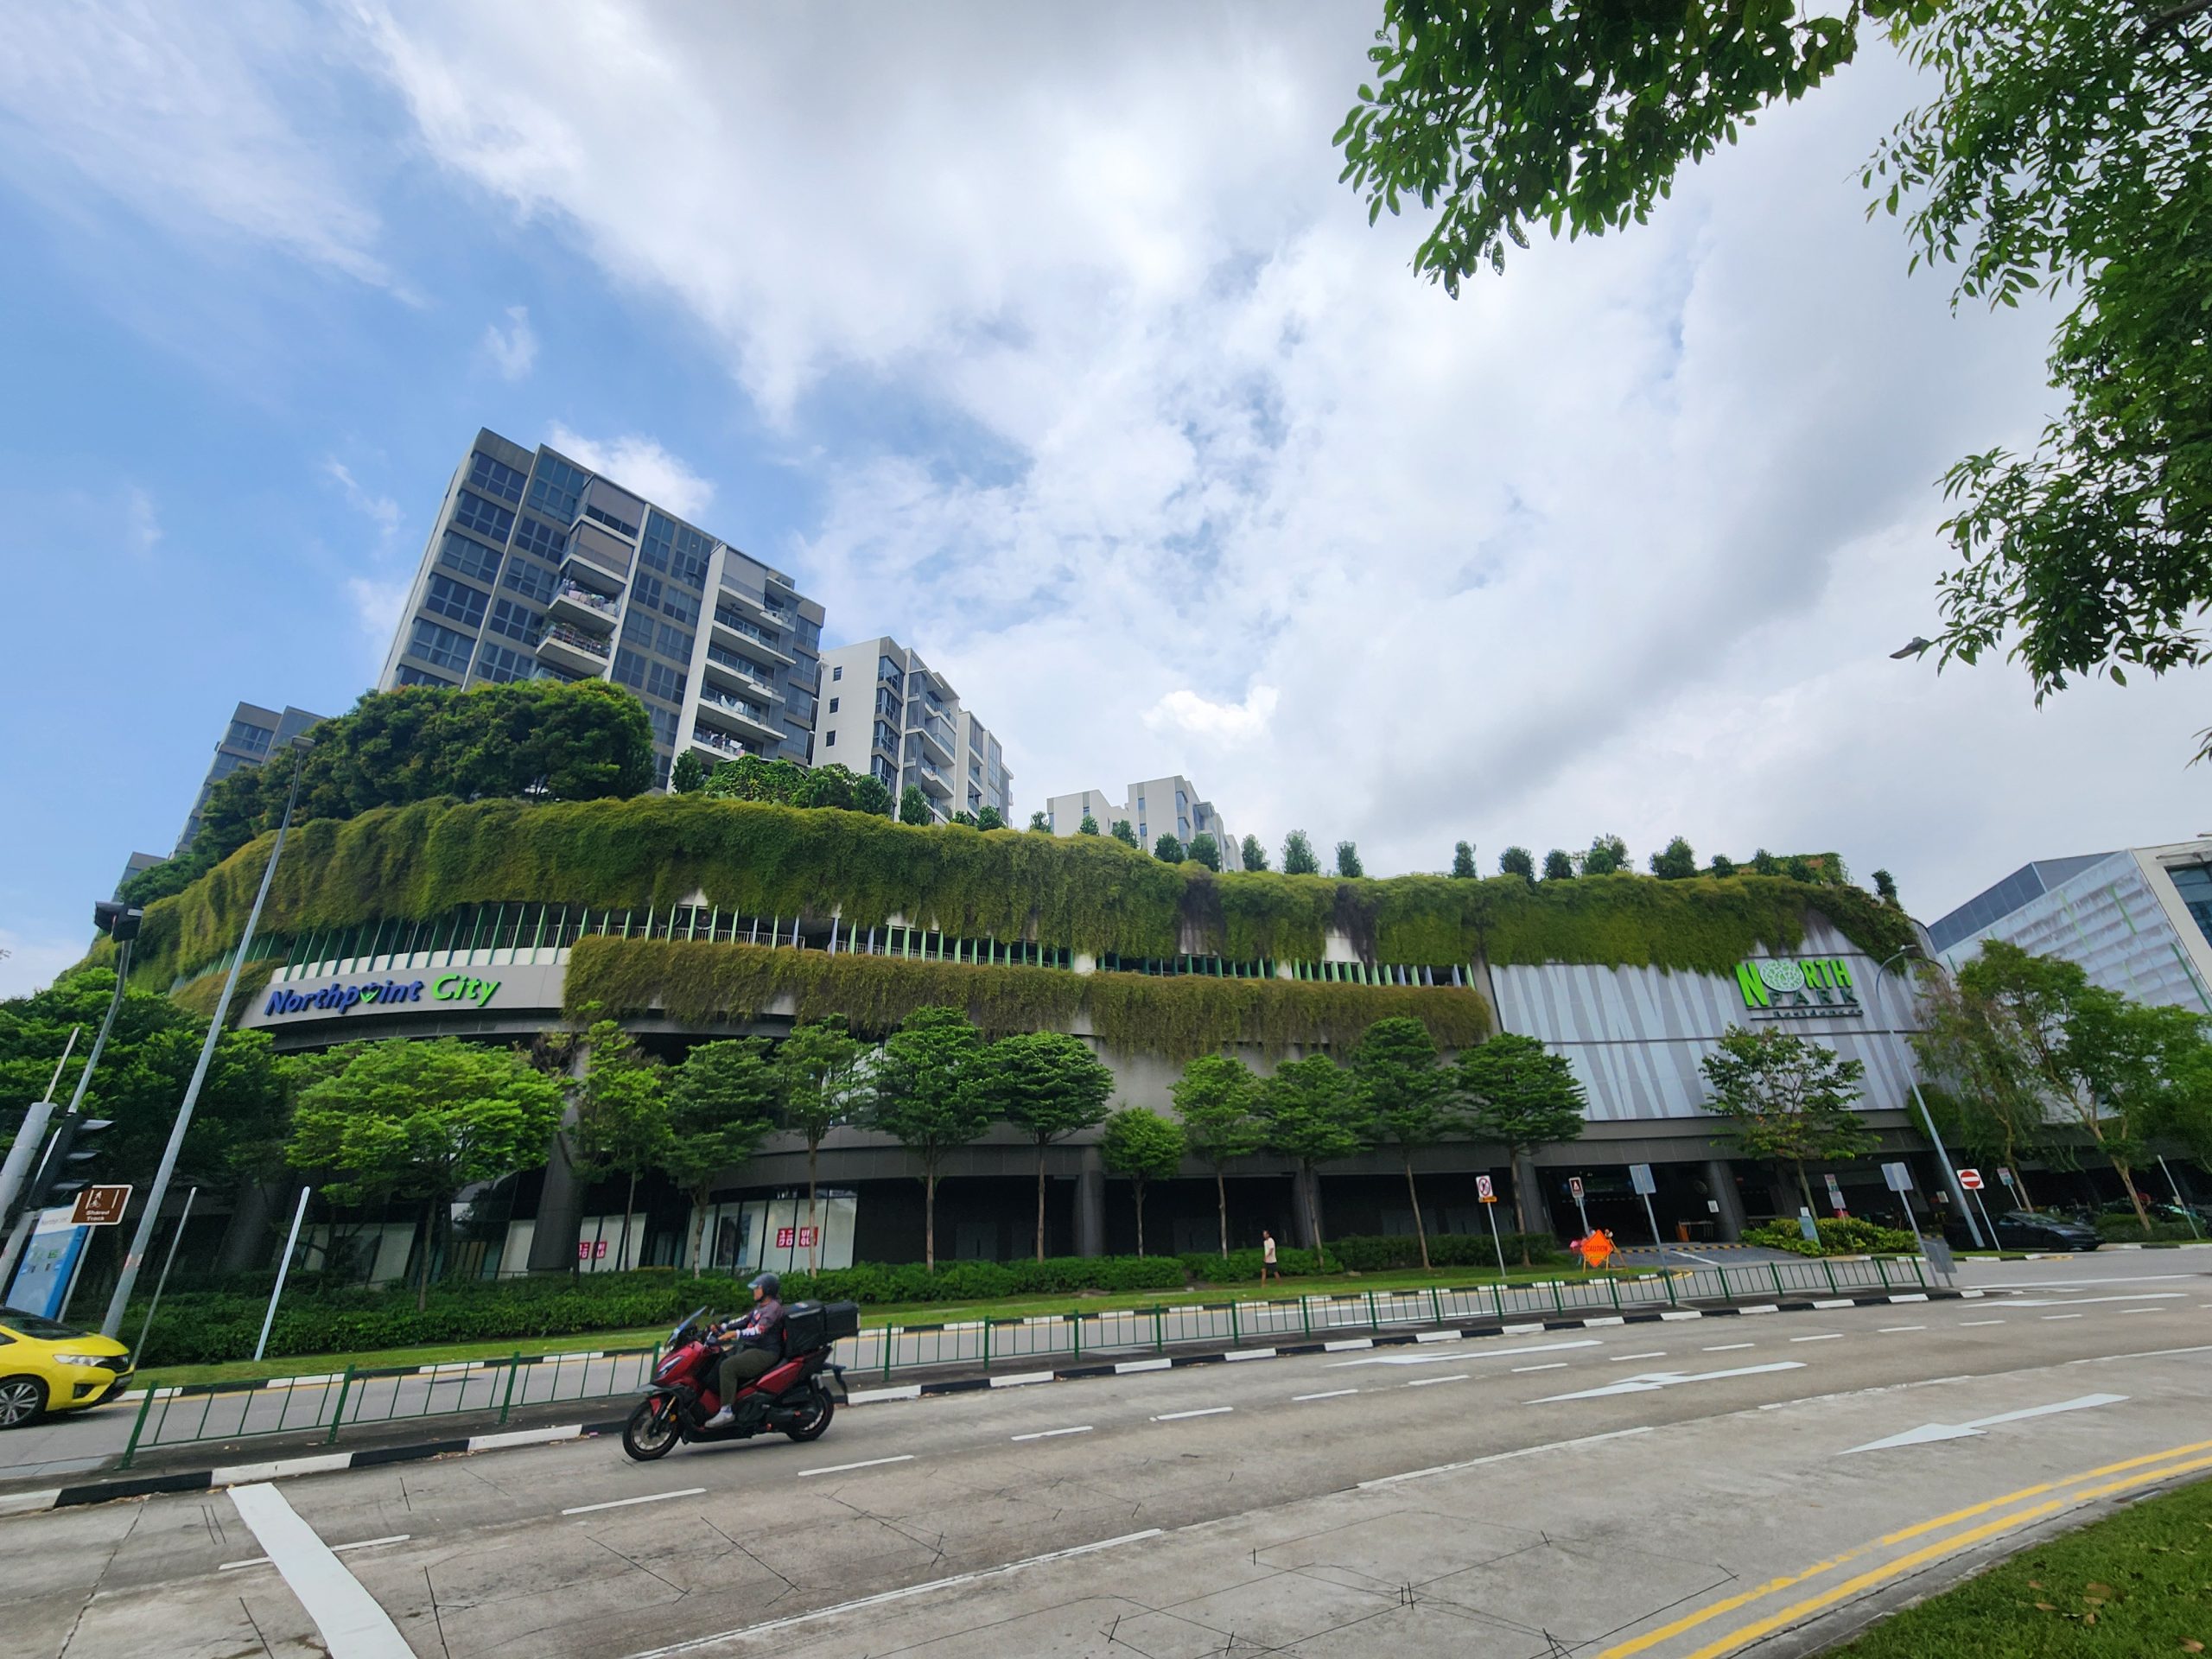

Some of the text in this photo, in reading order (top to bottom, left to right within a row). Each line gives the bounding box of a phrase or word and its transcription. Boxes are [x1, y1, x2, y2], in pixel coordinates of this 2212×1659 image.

[264, 973, 501, 1016] Northpoint City
[1769, 988, 1858, 1006] PARK
